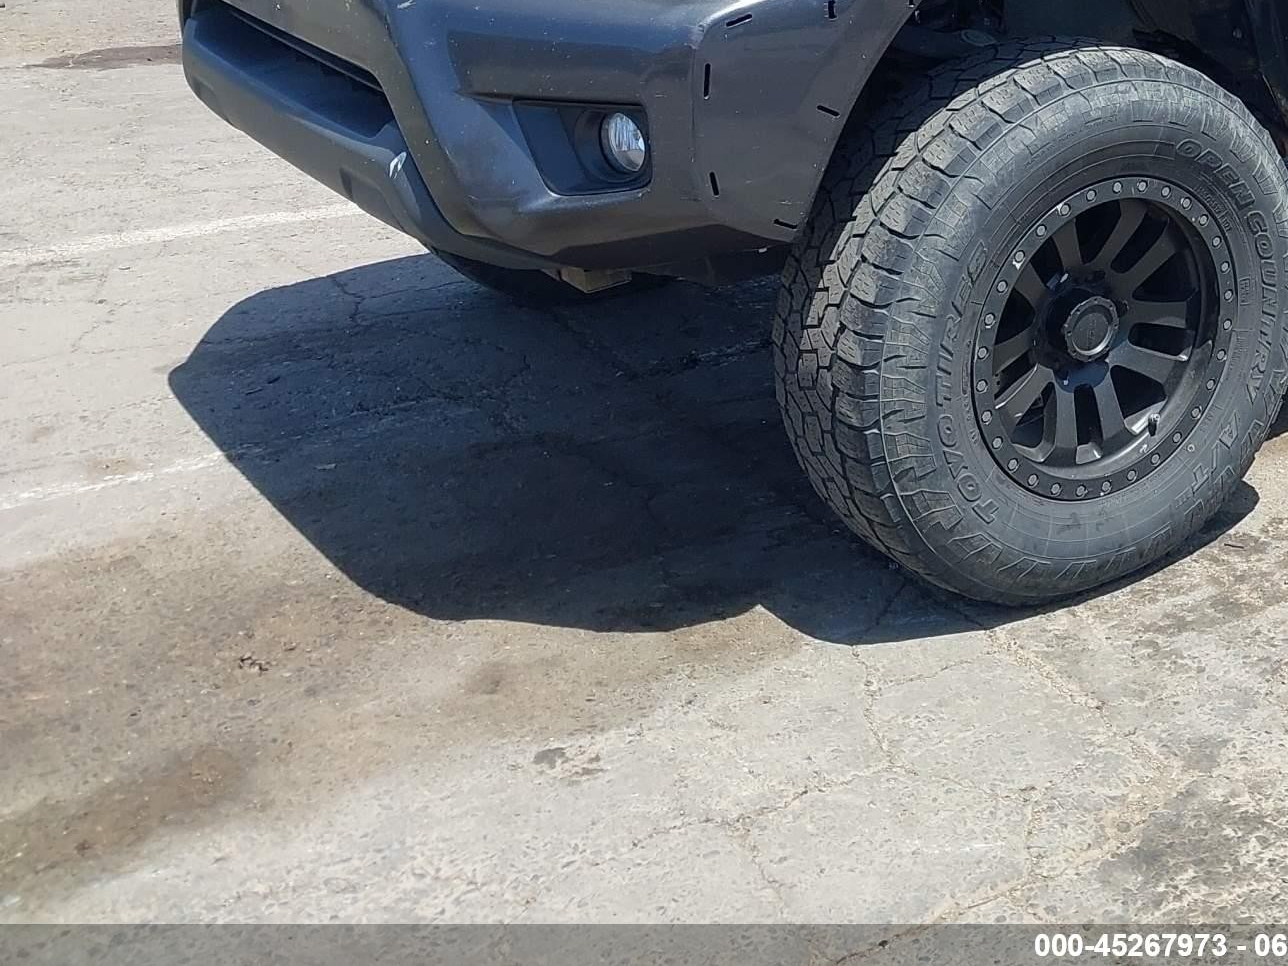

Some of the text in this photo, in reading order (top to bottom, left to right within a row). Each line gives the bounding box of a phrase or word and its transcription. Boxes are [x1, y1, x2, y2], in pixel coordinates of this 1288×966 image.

[936, 240, 999, 524] TOYO TIRES
[1176, 138, 1256, 211] OPEN
[1246, 210, 1278, 405] COUNTRY
